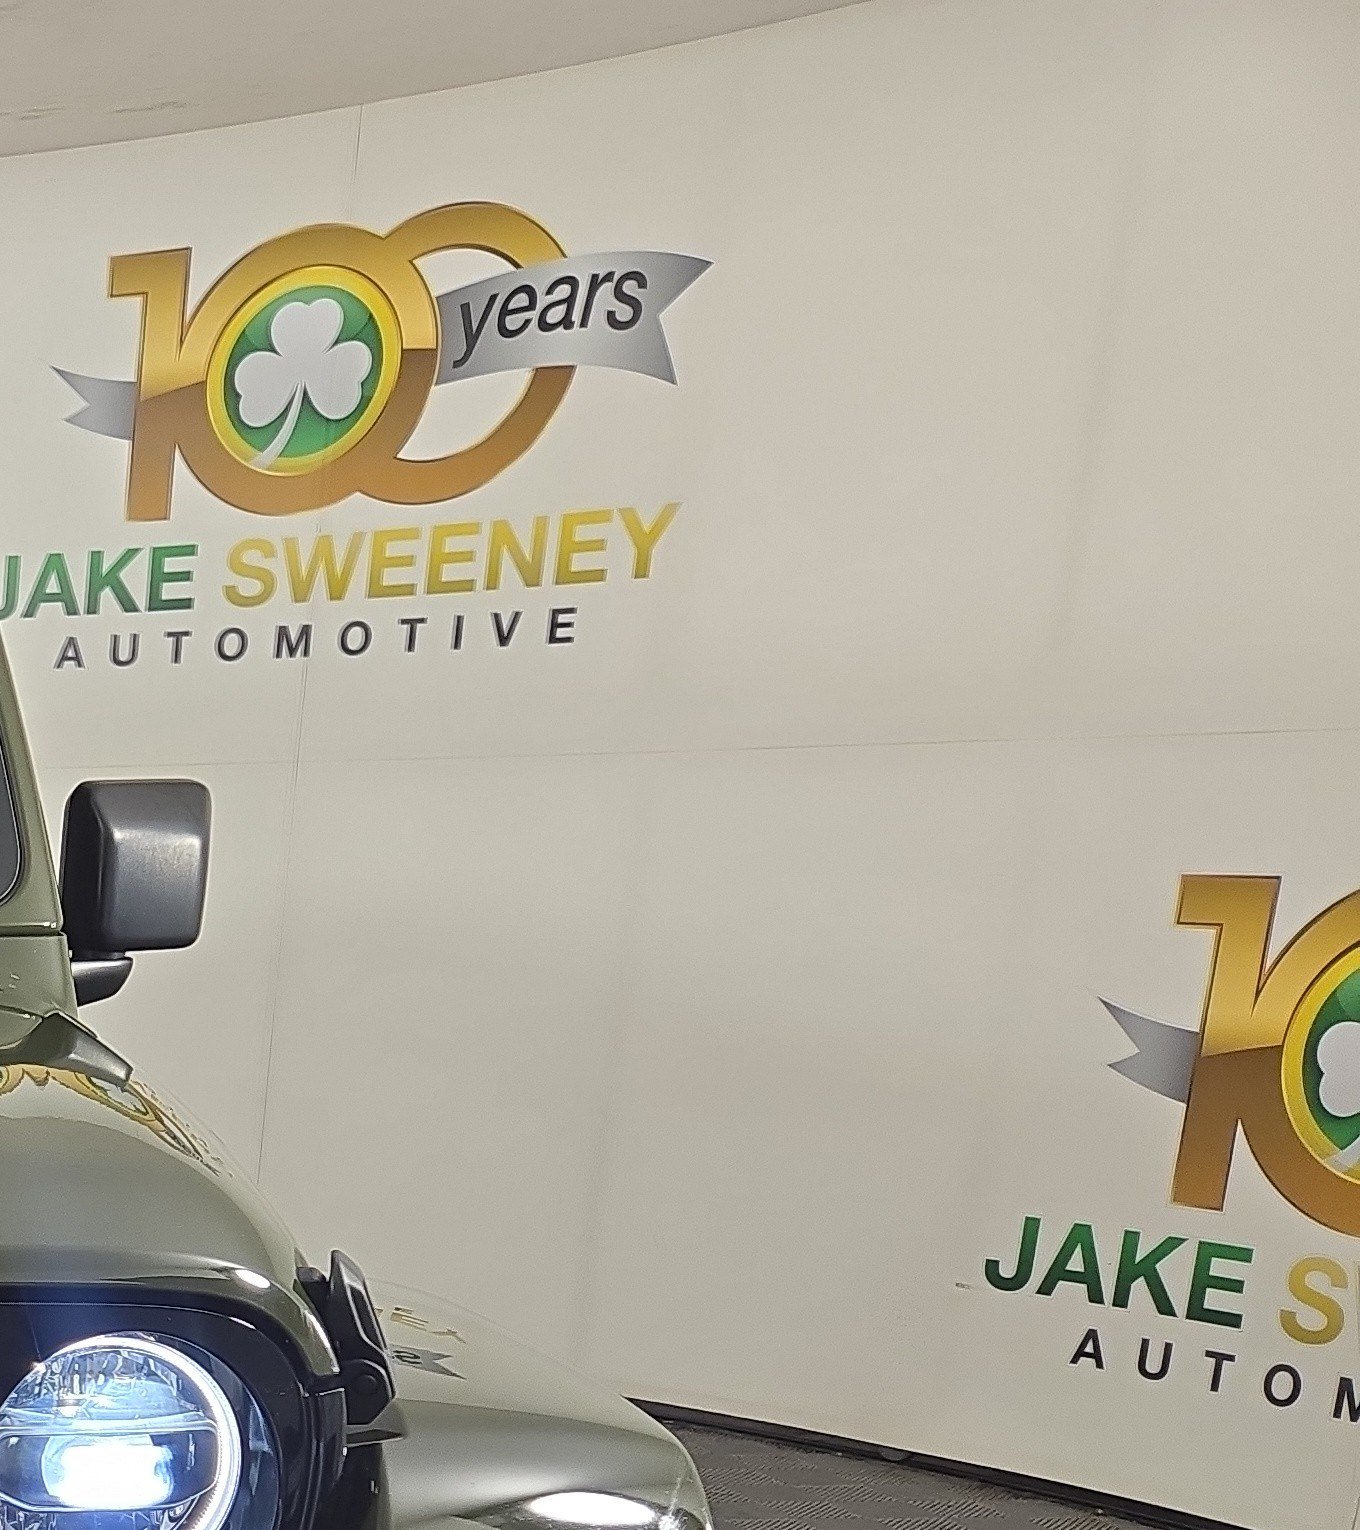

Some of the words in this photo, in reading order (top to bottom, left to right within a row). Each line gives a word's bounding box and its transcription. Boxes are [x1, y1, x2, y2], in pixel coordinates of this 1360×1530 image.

[451, 267, 648, 369] years
[222, 502, 680, 608] SWEENEY
[54, 607, 579, 671] AUTOMOTIVE
[984, 1215, 1255, 1330] JAKE
